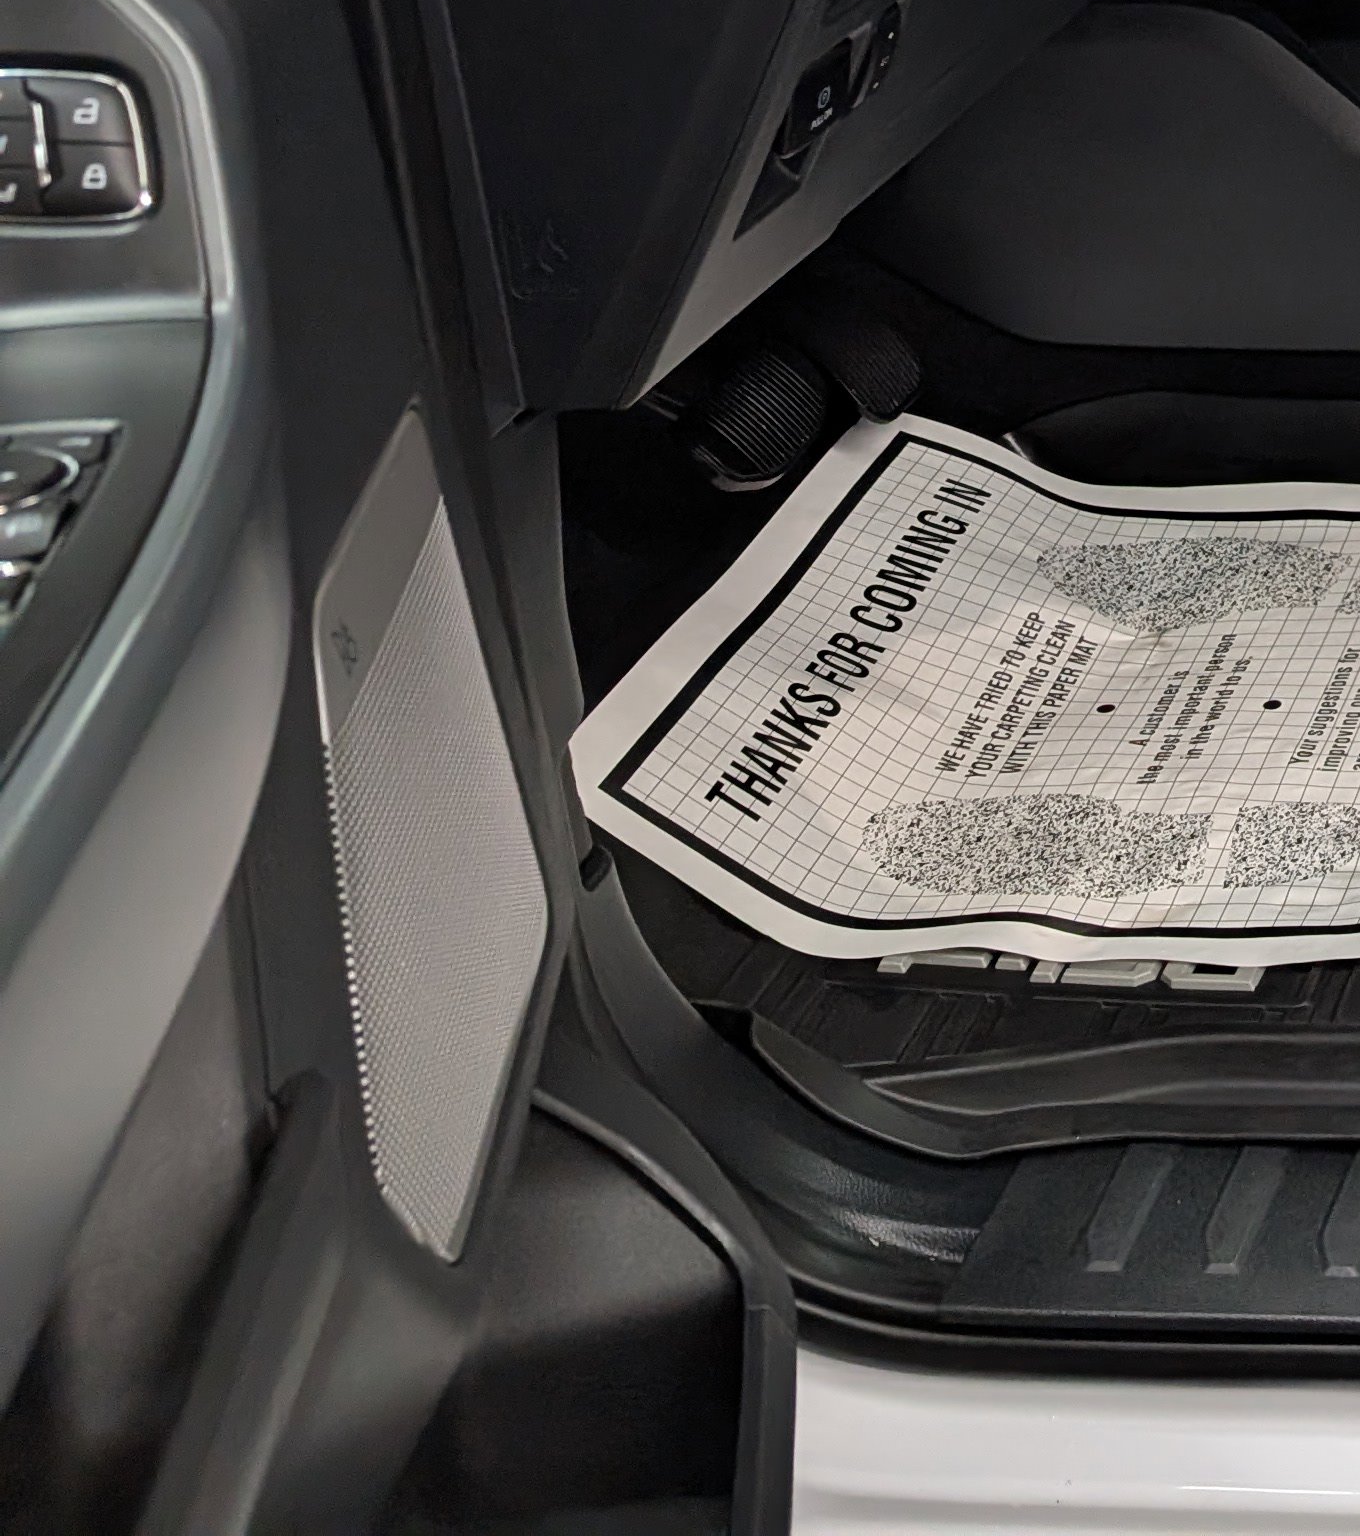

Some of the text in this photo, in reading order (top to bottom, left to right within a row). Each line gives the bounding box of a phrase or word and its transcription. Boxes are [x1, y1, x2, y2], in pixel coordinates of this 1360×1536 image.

[704, 478, 992, 822] THANKS FOR COMING IN
[934, 611, 1045, 772] WE HAVE TRIED TO KEEP
[964, 619, 1076, 777] YOUR CARPETING CLEAN
[1219, 675, 1242, 686] to
[1000, 635, 1098, 774] WITH THIS PAPER MAT
[1128, 670, 1190, 746] A customer is
[1136, 634, 1237, 784] the most important person
[1189, 724, 1216, 744] the
[1204, 690, 1235, 722] world
[1288, 739, 1319, 764] Your
[1307, 666, 1353, 736] suggestions
[1179, 749, 1204, 759] in
